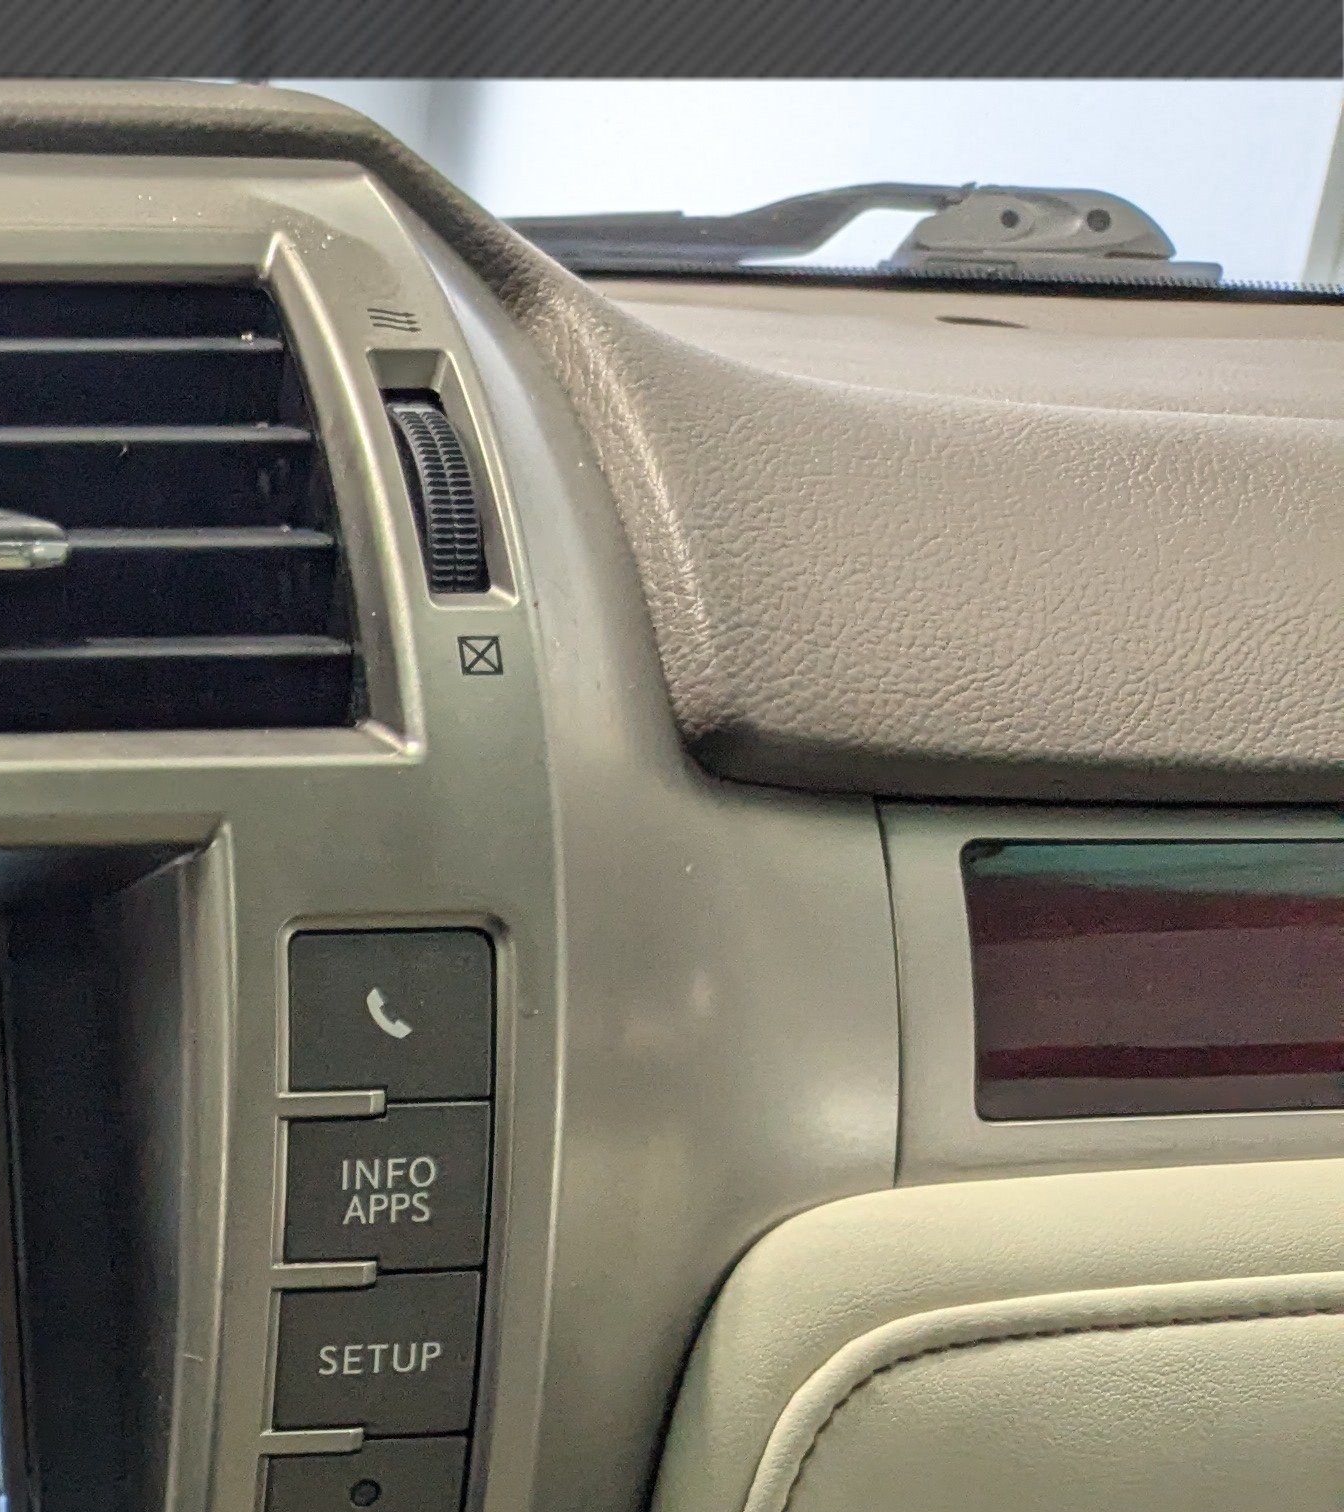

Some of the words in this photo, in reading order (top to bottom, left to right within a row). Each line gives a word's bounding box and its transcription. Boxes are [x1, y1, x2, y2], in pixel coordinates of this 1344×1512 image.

[342, 1157, 437, 1191] INFO
[343, 1192, 431, 1225] APPS
[319, 1342, 443, 1377] SETUP
